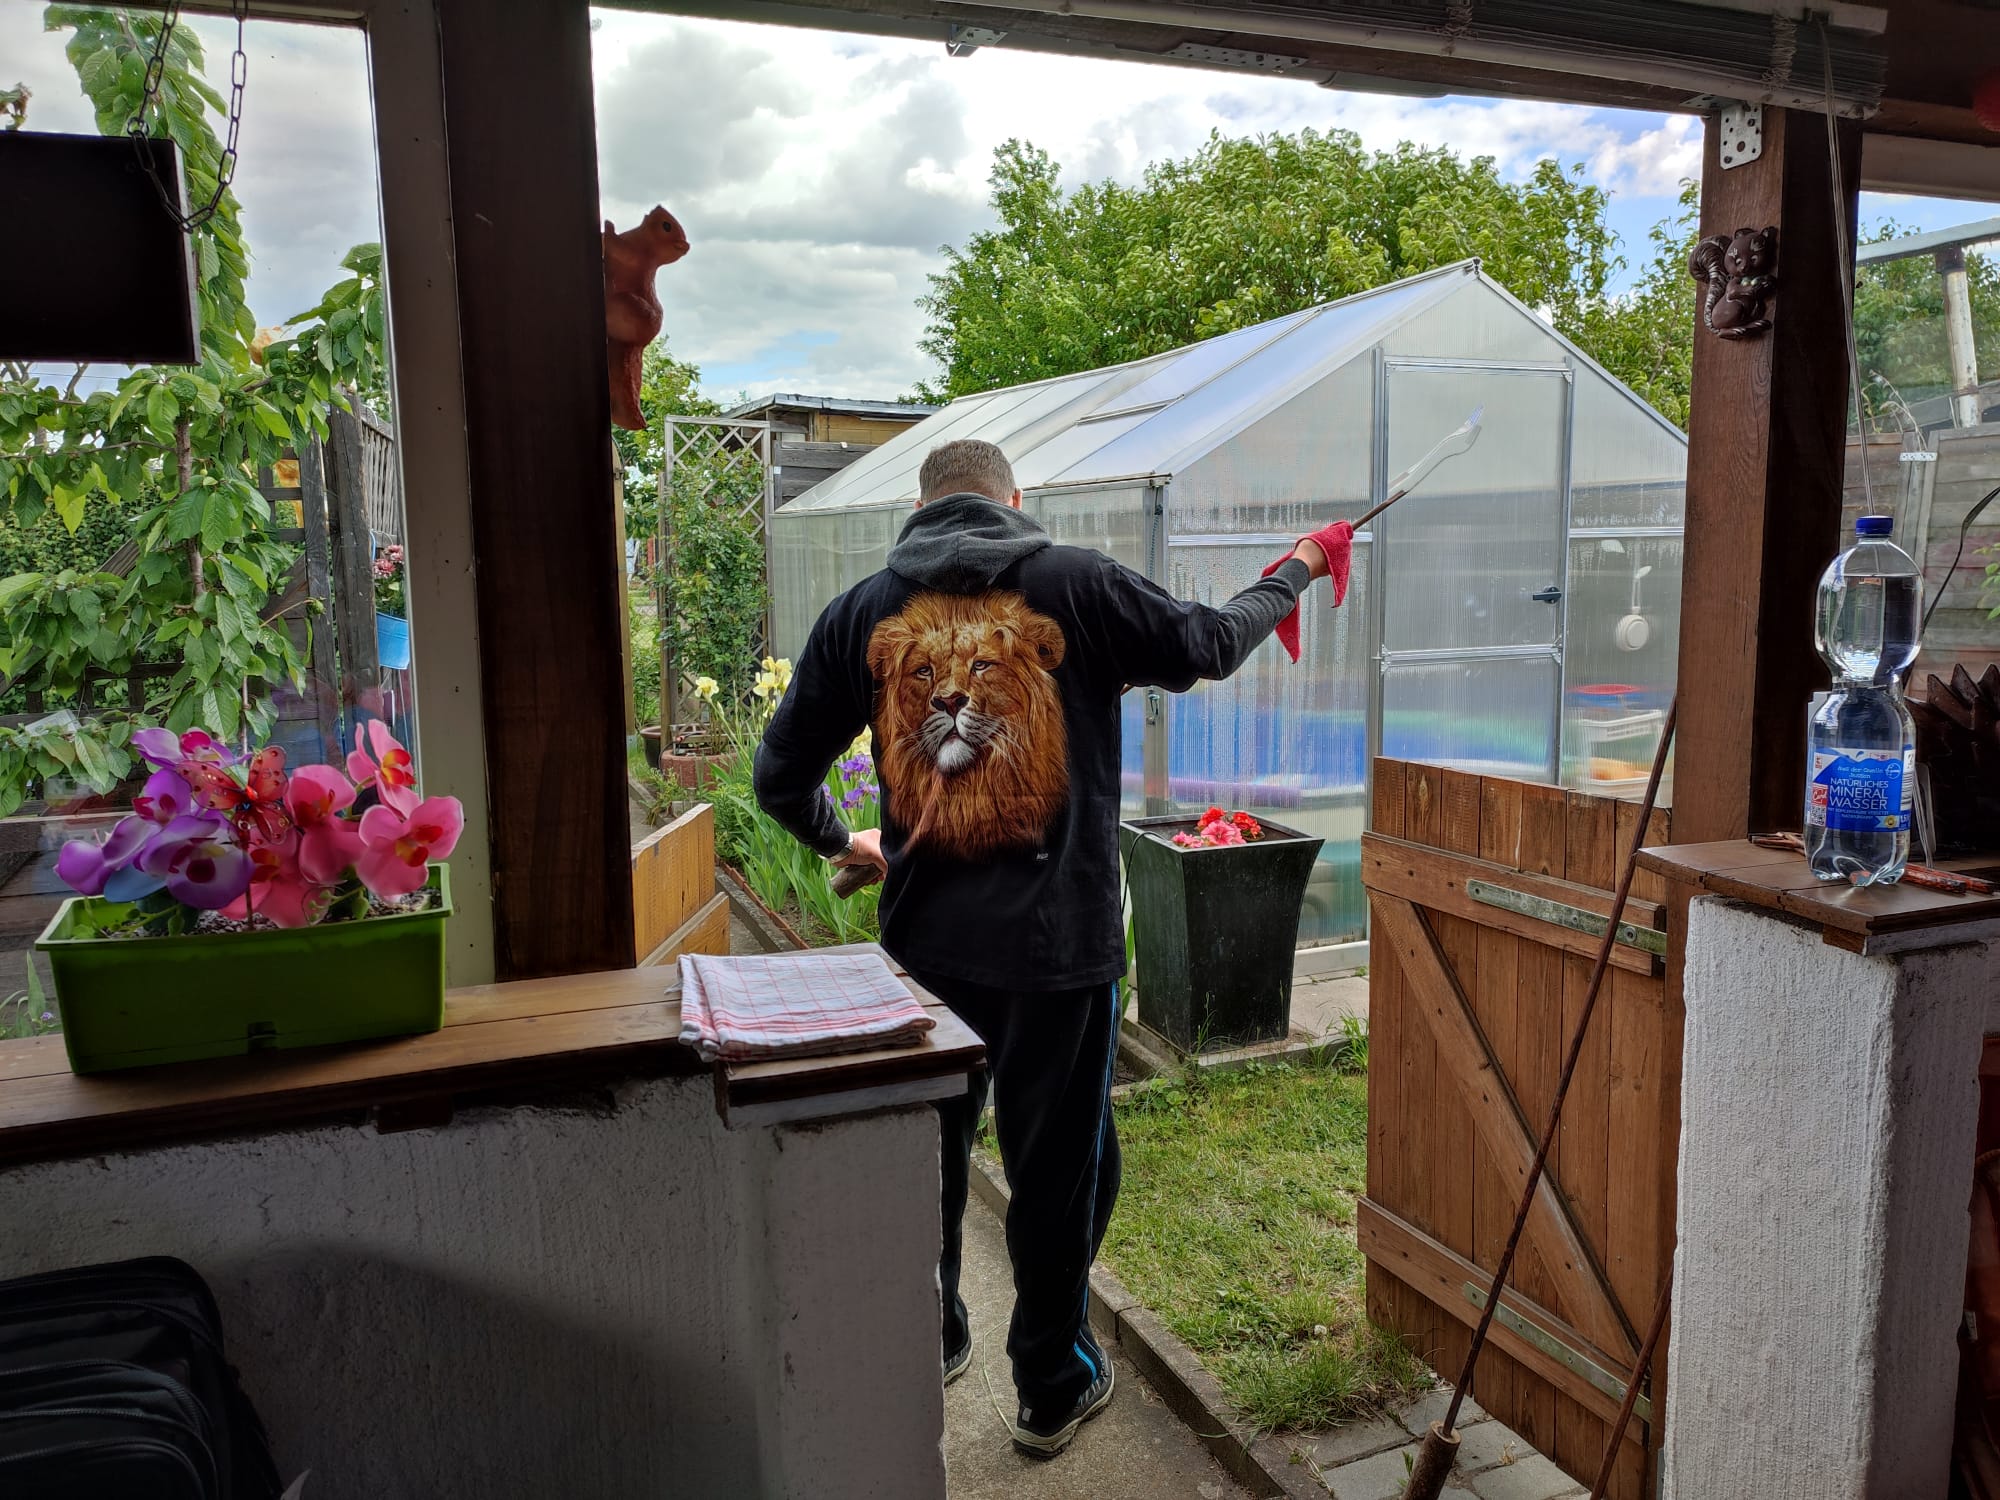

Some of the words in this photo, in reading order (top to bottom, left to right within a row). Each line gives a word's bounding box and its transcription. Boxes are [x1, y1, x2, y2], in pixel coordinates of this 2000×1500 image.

[1830, 778, 1889, 788] NATÜRLICHES
[1829, 786, 1888, 799] MINERAL
[1829, 796, 1887, 810] WASSER
